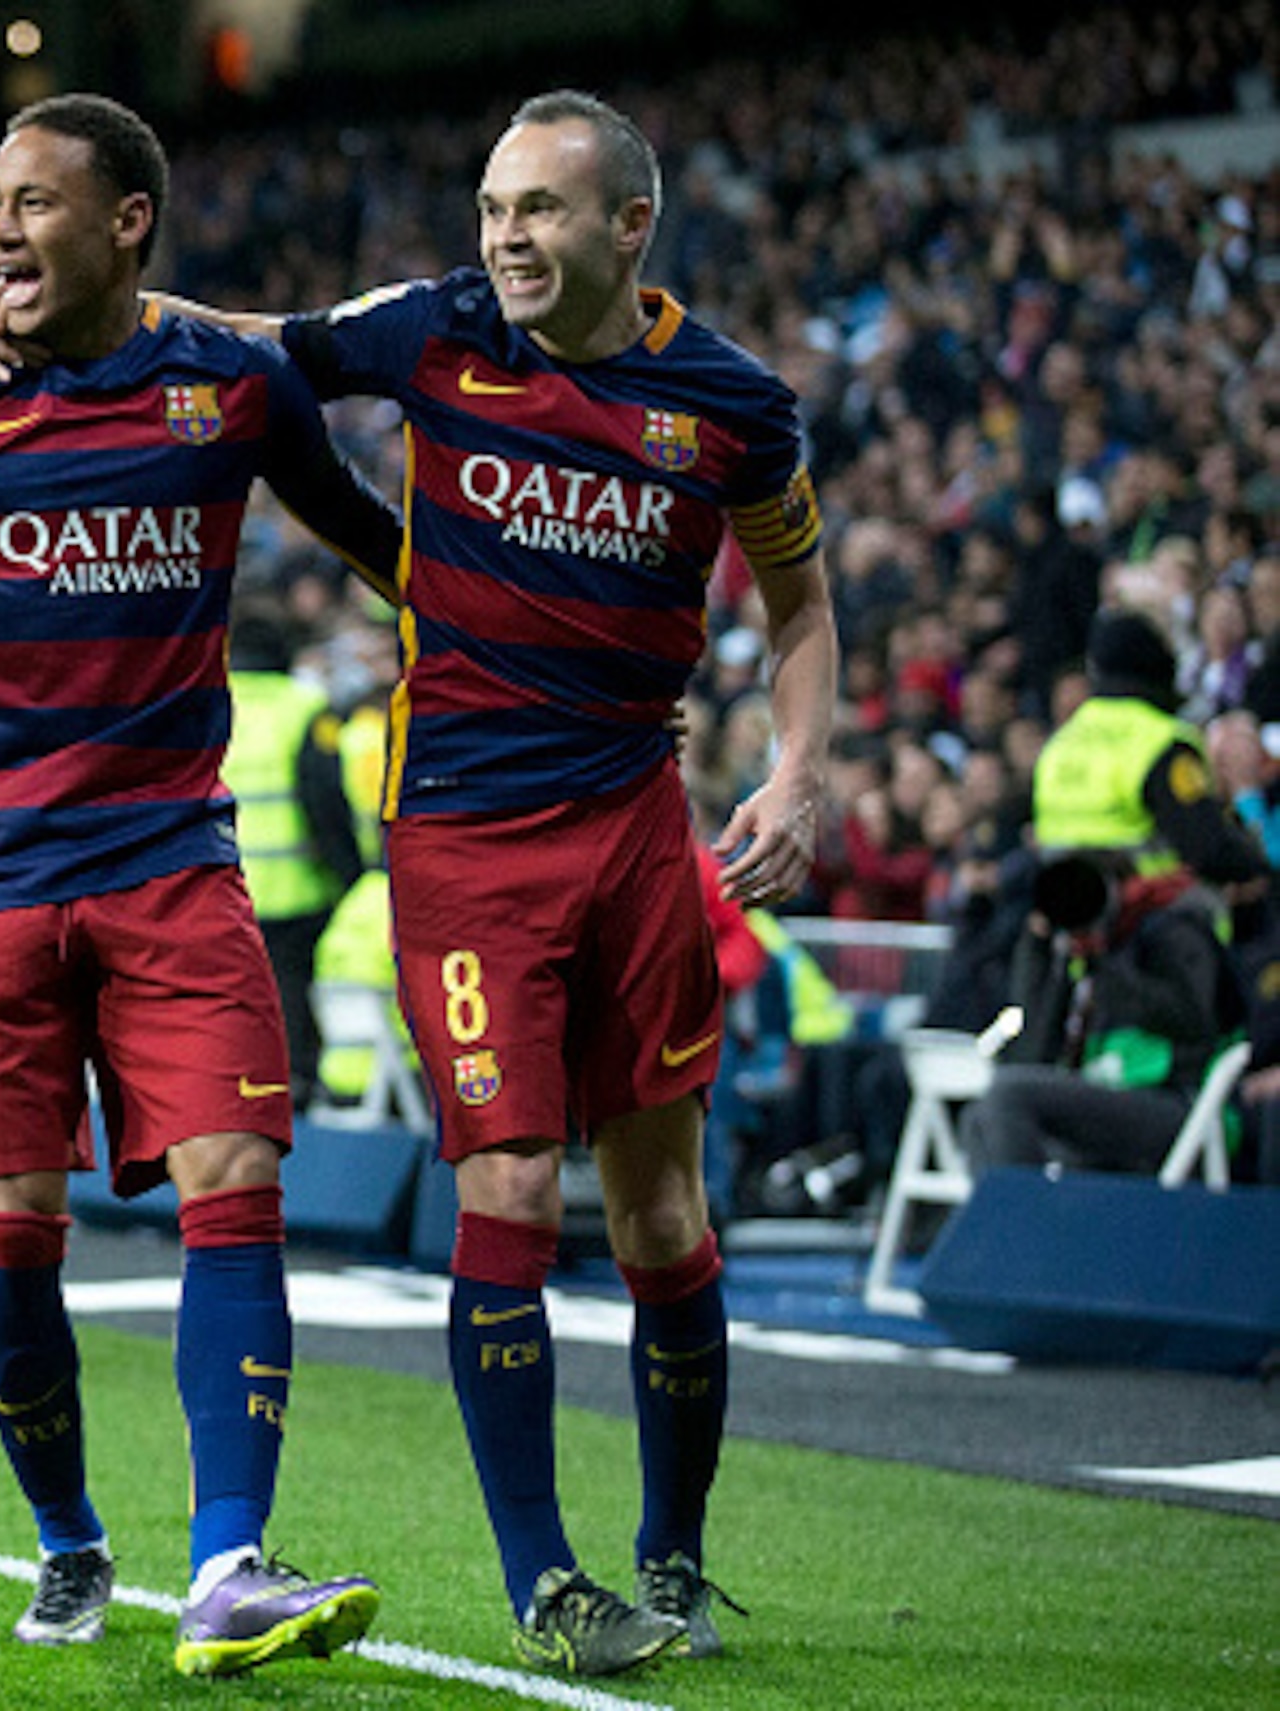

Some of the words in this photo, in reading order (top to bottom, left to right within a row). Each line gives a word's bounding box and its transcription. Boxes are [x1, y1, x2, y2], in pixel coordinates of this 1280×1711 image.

[460, 454, 674, 535] QATAR
[502, 512, 666, 567] AIRWAYS
[49, 556, 201, 595] AIRWAYS
[441, 949, 488, 1045] 8
